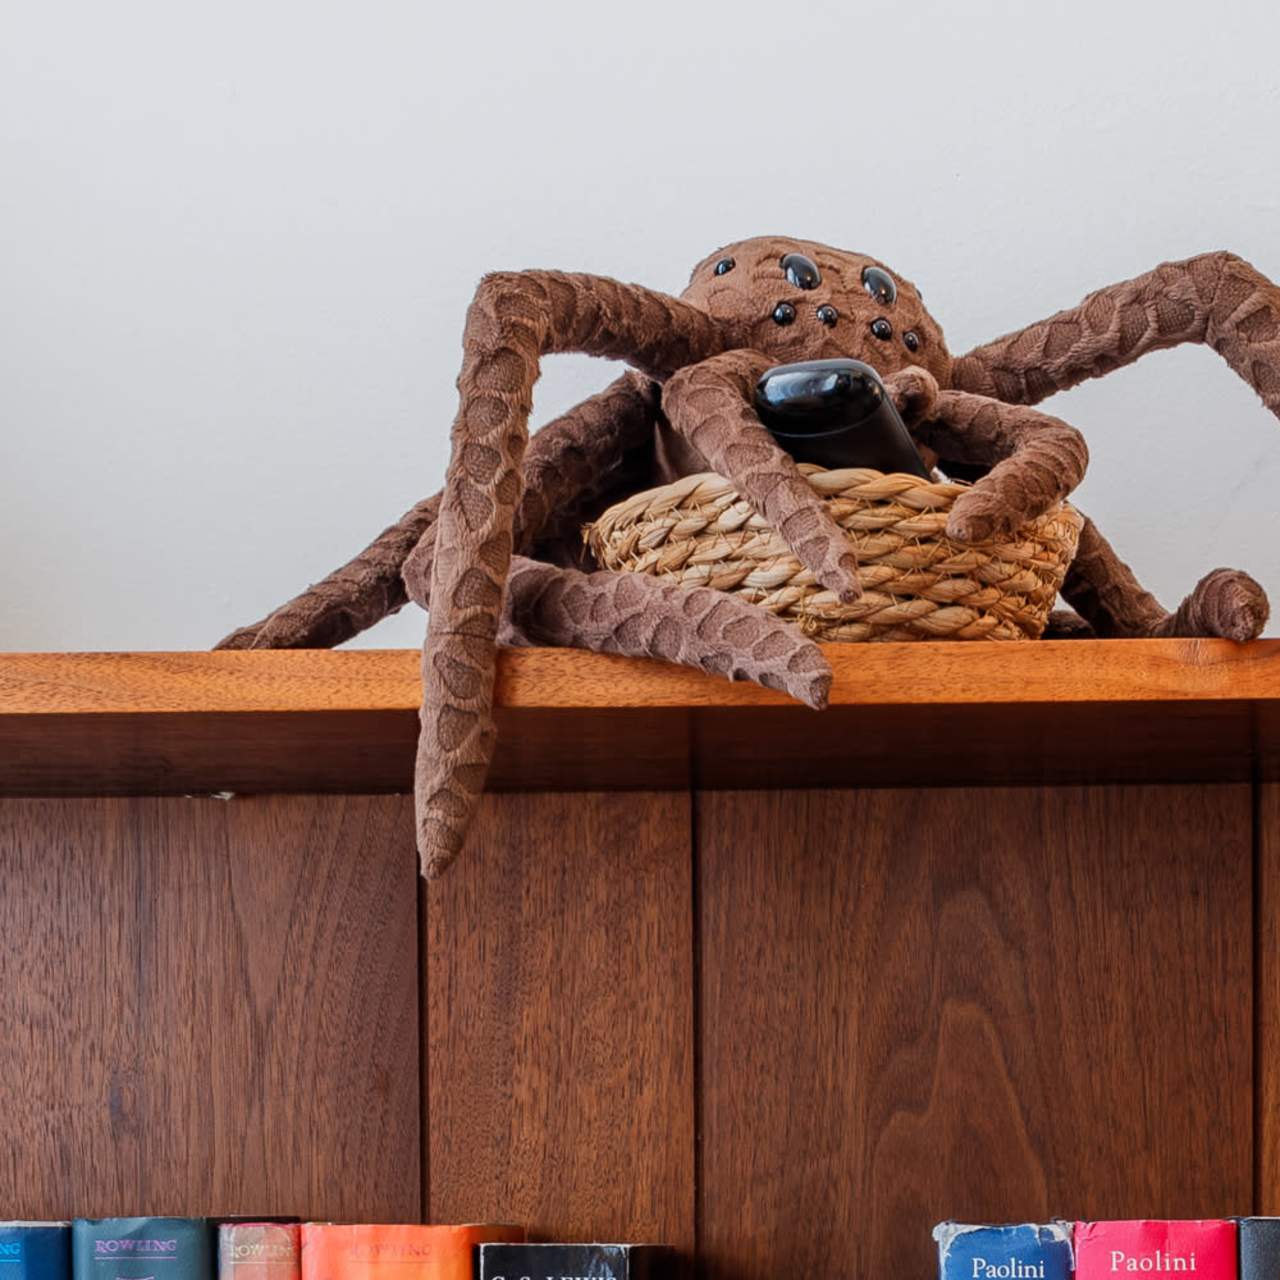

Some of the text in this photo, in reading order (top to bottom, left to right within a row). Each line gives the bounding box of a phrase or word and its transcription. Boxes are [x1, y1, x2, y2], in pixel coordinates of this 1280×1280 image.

[95, 1239, 176, 1253] ROWLING
[972, 1257, 1046, 1280] Paolini
[1110, 1250, 1197, 1272] Paolini
